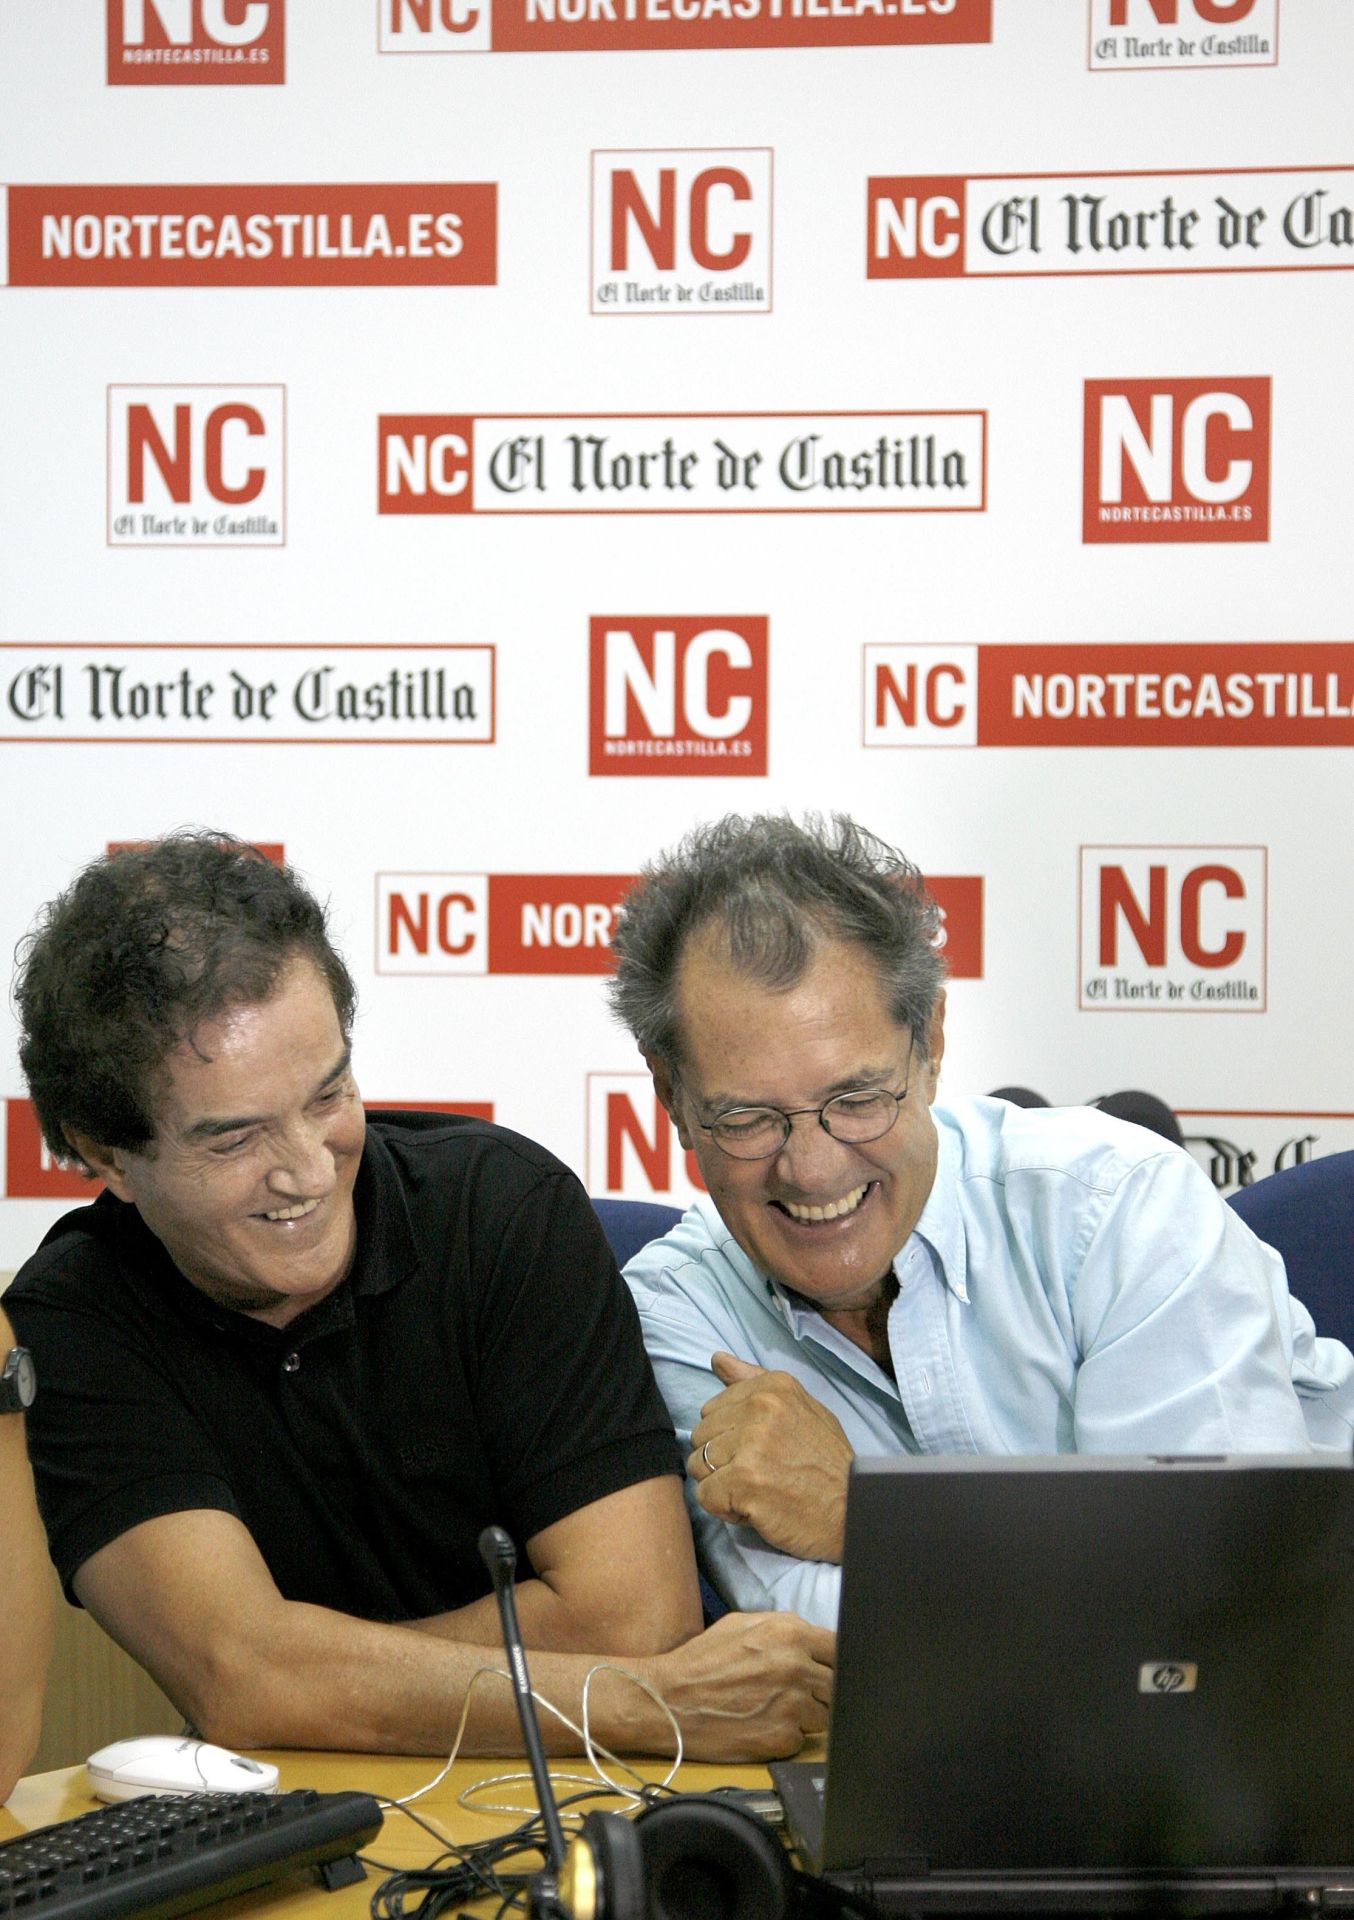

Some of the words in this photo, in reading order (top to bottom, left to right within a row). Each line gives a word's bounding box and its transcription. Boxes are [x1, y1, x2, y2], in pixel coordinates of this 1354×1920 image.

[122, 48, 270, 64] NORTECASTILLA.ES
[1095, 37, 1117, 60] El
[1123, 36, 1174, 59] Norte
[1177, 37, 1197, 57] de
[1200, 34, 1271, 57] Castilla
[42, 213, 464, 259] NORTECASTILLA.ES
[610, 166, 753, 272] NC
[875, 196, 960, 259] NC
[980, 195, 1041, 255] El
[1062, 193, 1200, 254] Norte
[1215, 196, 1267, 250] de
[597, 282, 619, 304] El
[624, 281, 673, 304] Norte
[676, 283, 695, 303] de
[697, 281, 766, 303] Castilla
[127, 402, 267, 505] NC
[385, 434, 469, 496] NC
[488, 435, 547, 494] El
[566, 434, 700, 493] Norte
[713, 438, 763, 492] de
[778, 433, 969, 493] Castilla
[1100, 391, 1254, 504] NC
[113, 514, 136, 537] El
[142, 513, 188, 537] Norte
[191, 515, 210, 537] de
[212, 514, 280, 537] Castilla
[1100, 505, 1253, 522] NORTECASTILLA.ES
[8, 664, 65, 722] El
[85, 663, 215, 722] Norte
[229, 669, 278, 722] de
[292, 665, 478, 723] Castilla
[605, 629, 753, 739] NC
[875, 663, 967, 728] NC
[1013, 672, 1354, 718] NORTECASTILL
[605, 741, 752, 757] NORTECASTILLA.ES
[388, 892, 477, 956] NC
[1099, 864, 1247, 970] NC
[1085, 977, 1109, 1000] El
[1113, 977, 1164, 1001] Norte
[1167, 978, 1187, 1001] de
[1189, 978, 1260, 1001] Castilla
